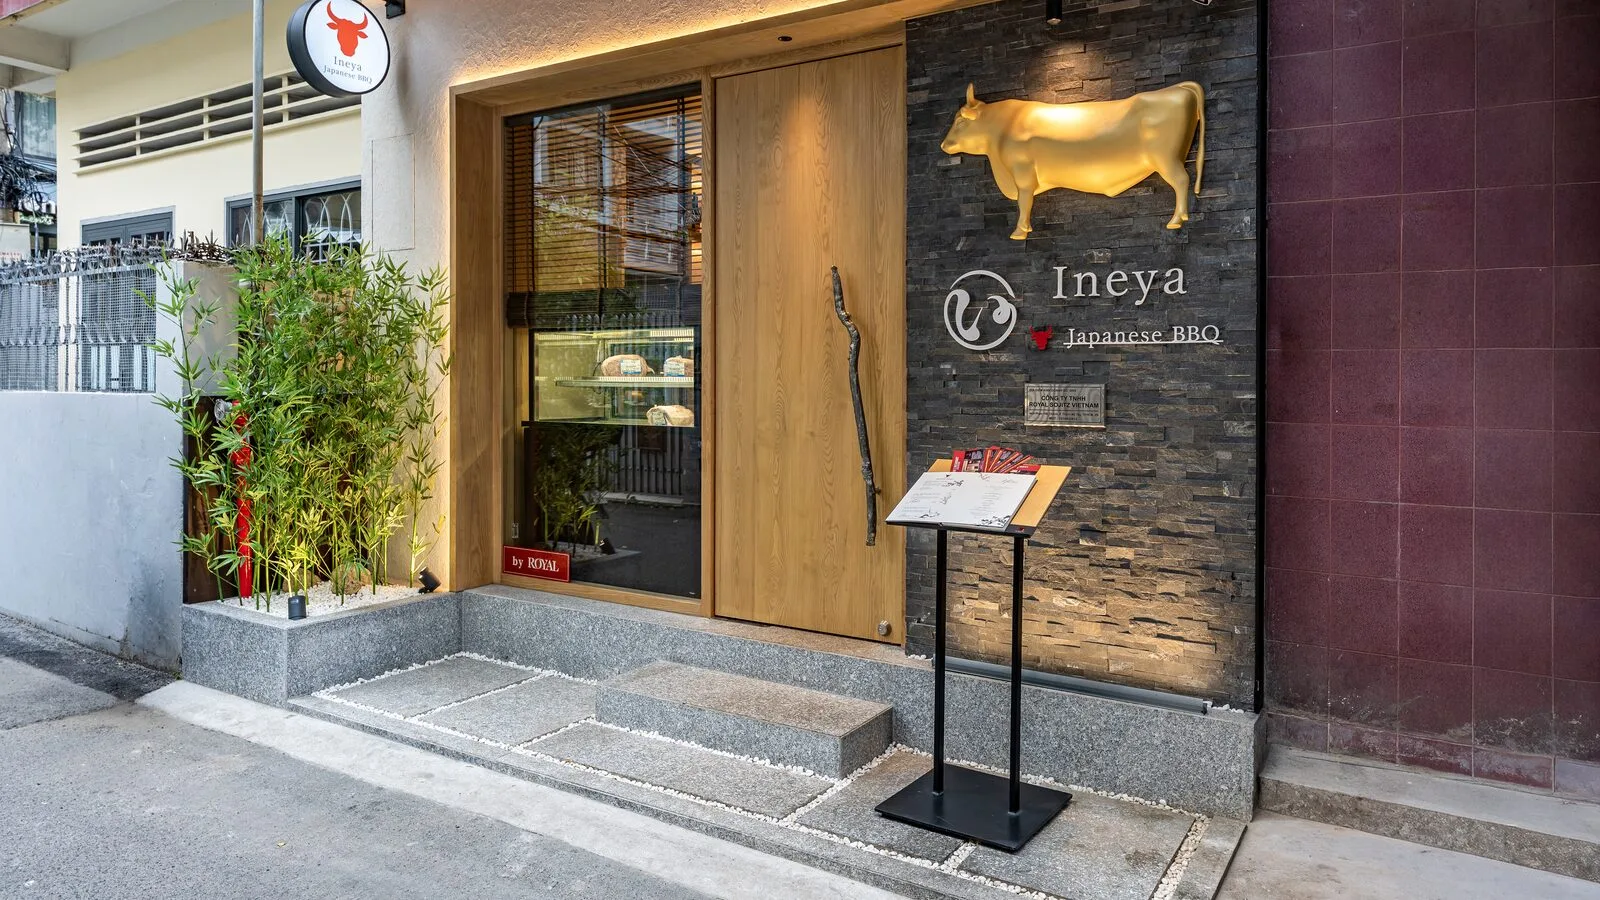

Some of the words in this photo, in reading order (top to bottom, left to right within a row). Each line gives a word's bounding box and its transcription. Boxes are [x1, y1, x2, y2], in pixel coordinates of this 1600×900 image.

[334, 56, 362, 71] Ineya
[323, 65, 355, 79] Japanese
[357, 74, 373, 84] BBQ
[1052, 266, 1187, 306] Ineya
[1067, 328, 1162, 349] Japanese
[1172, 324, 1221, 345] BBQ
[512, 555, 523, 568] by
[527, 556, 559, 572] ROYAL
